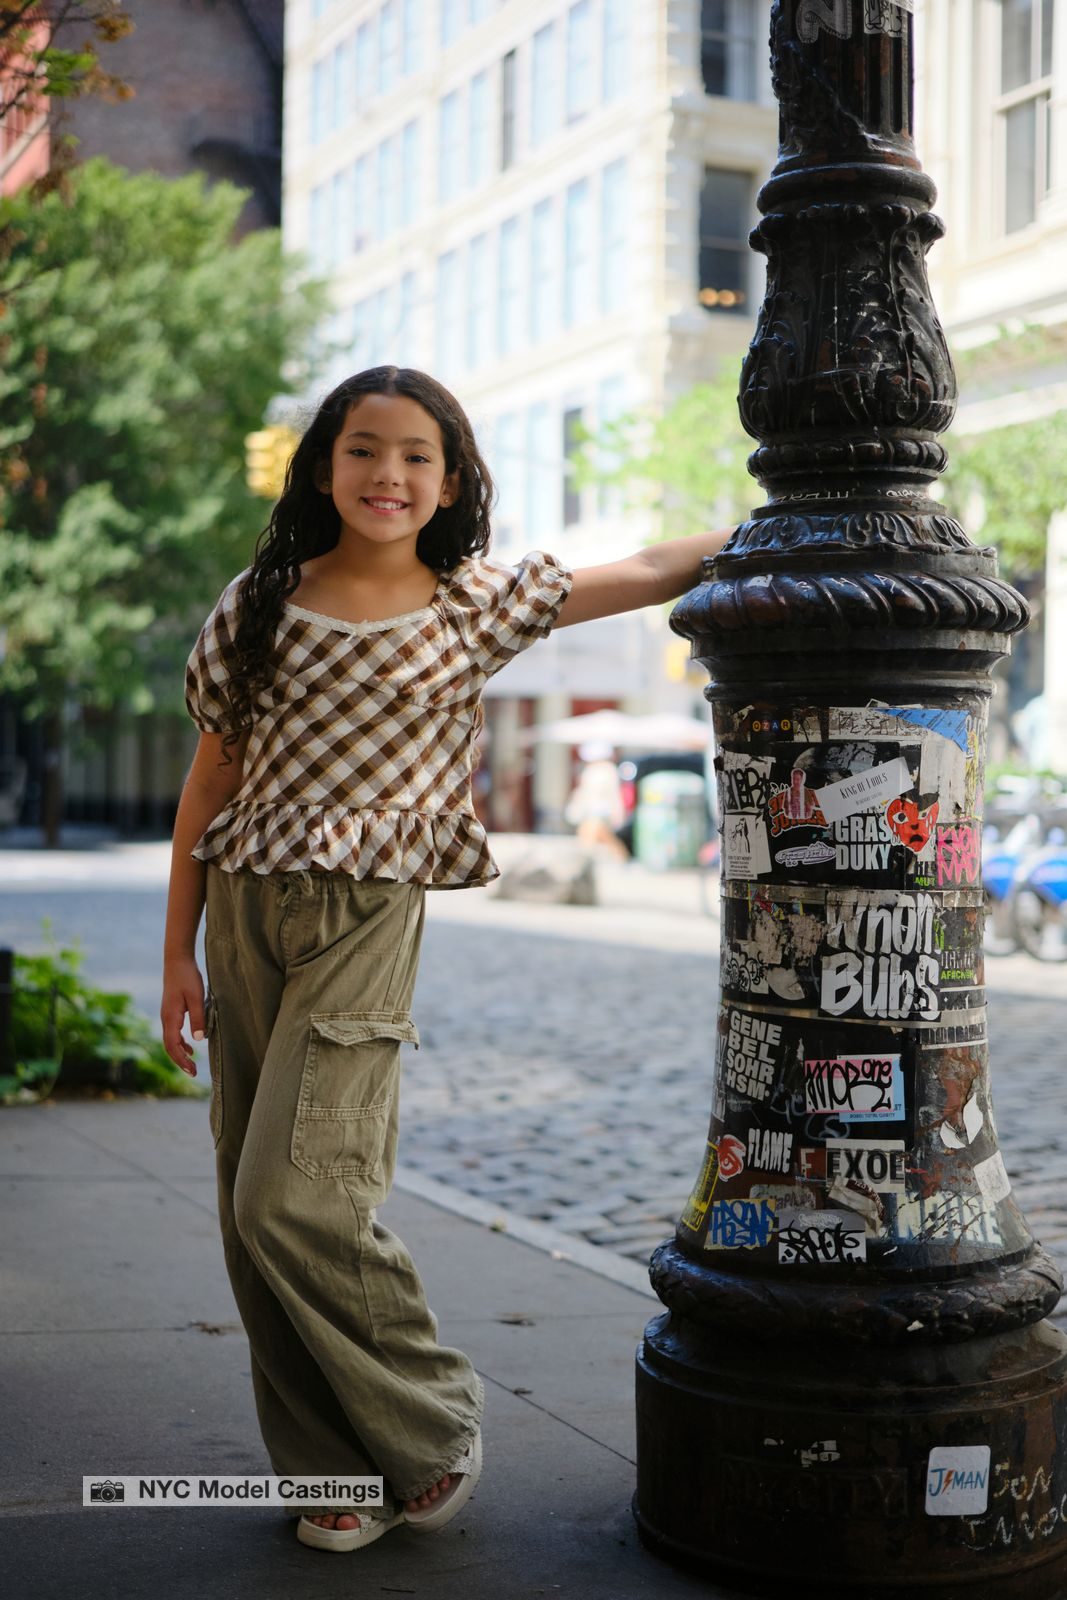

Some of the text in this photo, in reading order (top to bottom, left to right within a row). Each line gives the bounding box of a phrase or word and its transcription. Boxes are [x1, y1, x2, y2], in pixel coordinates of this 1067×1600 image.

[835, 844, 892, 871] DUKY
[728, 1028, 776, 1065] BEL
[730, 1010, 783, 1047] GENE
[726, 1047, 775, 1085] SOHR
[747, 1127, 793, 1174] FLAME
